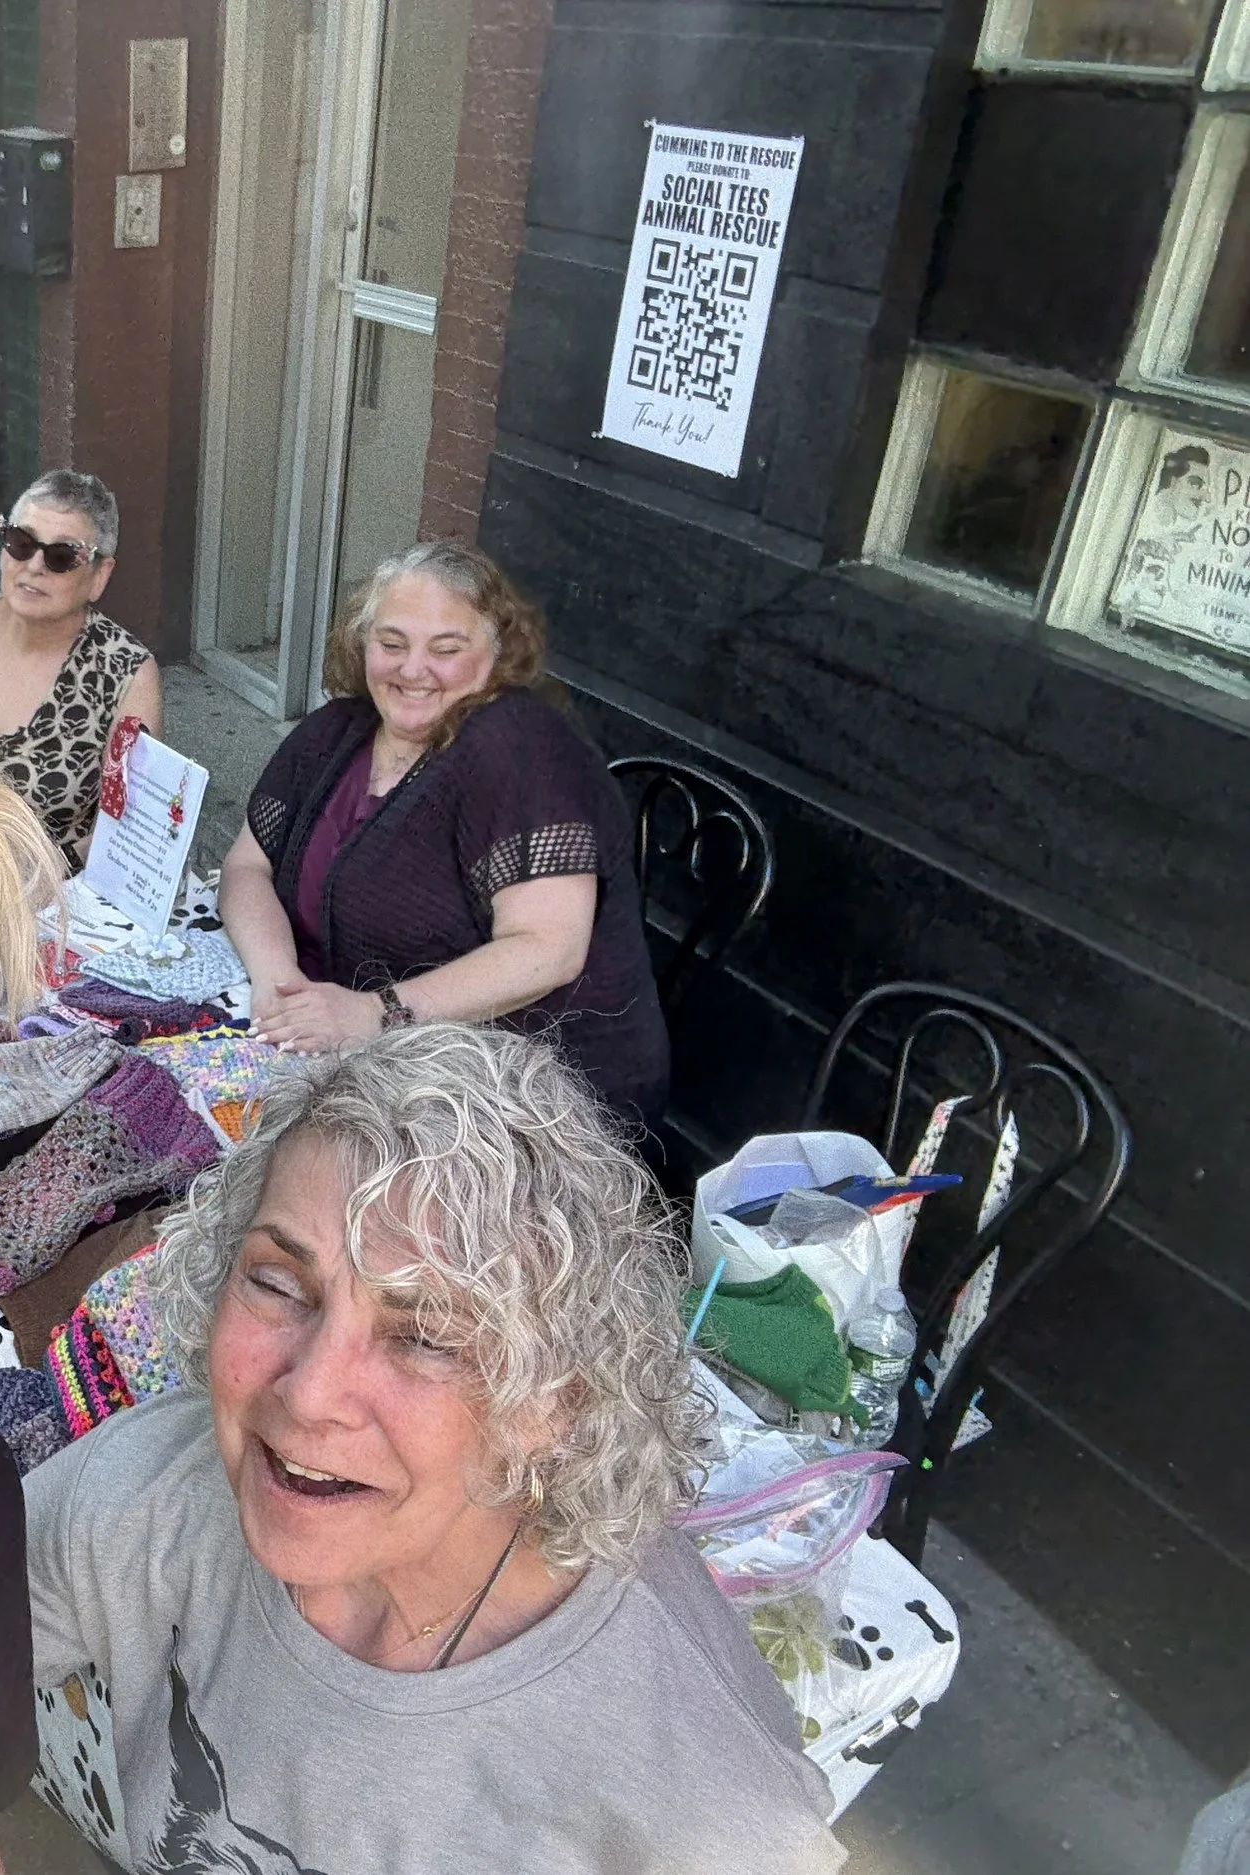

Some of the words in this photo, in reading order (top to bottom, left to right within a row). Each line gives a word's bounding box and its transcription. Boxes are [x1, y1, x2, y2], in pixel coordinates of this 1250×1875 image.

[655, 134, 708, 157] CUMMING
[711, 141, 725, 160] TO
[727, 143, 749, 164] THE
[750, 146, 797, 170] RESCUE
[686, 161, 712, 175] PLEASE
[662, 174, 723, 209] SOCIAL
[728, 183, 770, 217] TEES
[642, 199, 706, 236] ANIMAL
[710, 211, 781, 249] RESCUE
[633, 401, 674, 437] Thank
[674, 414, 715, 446] You!
